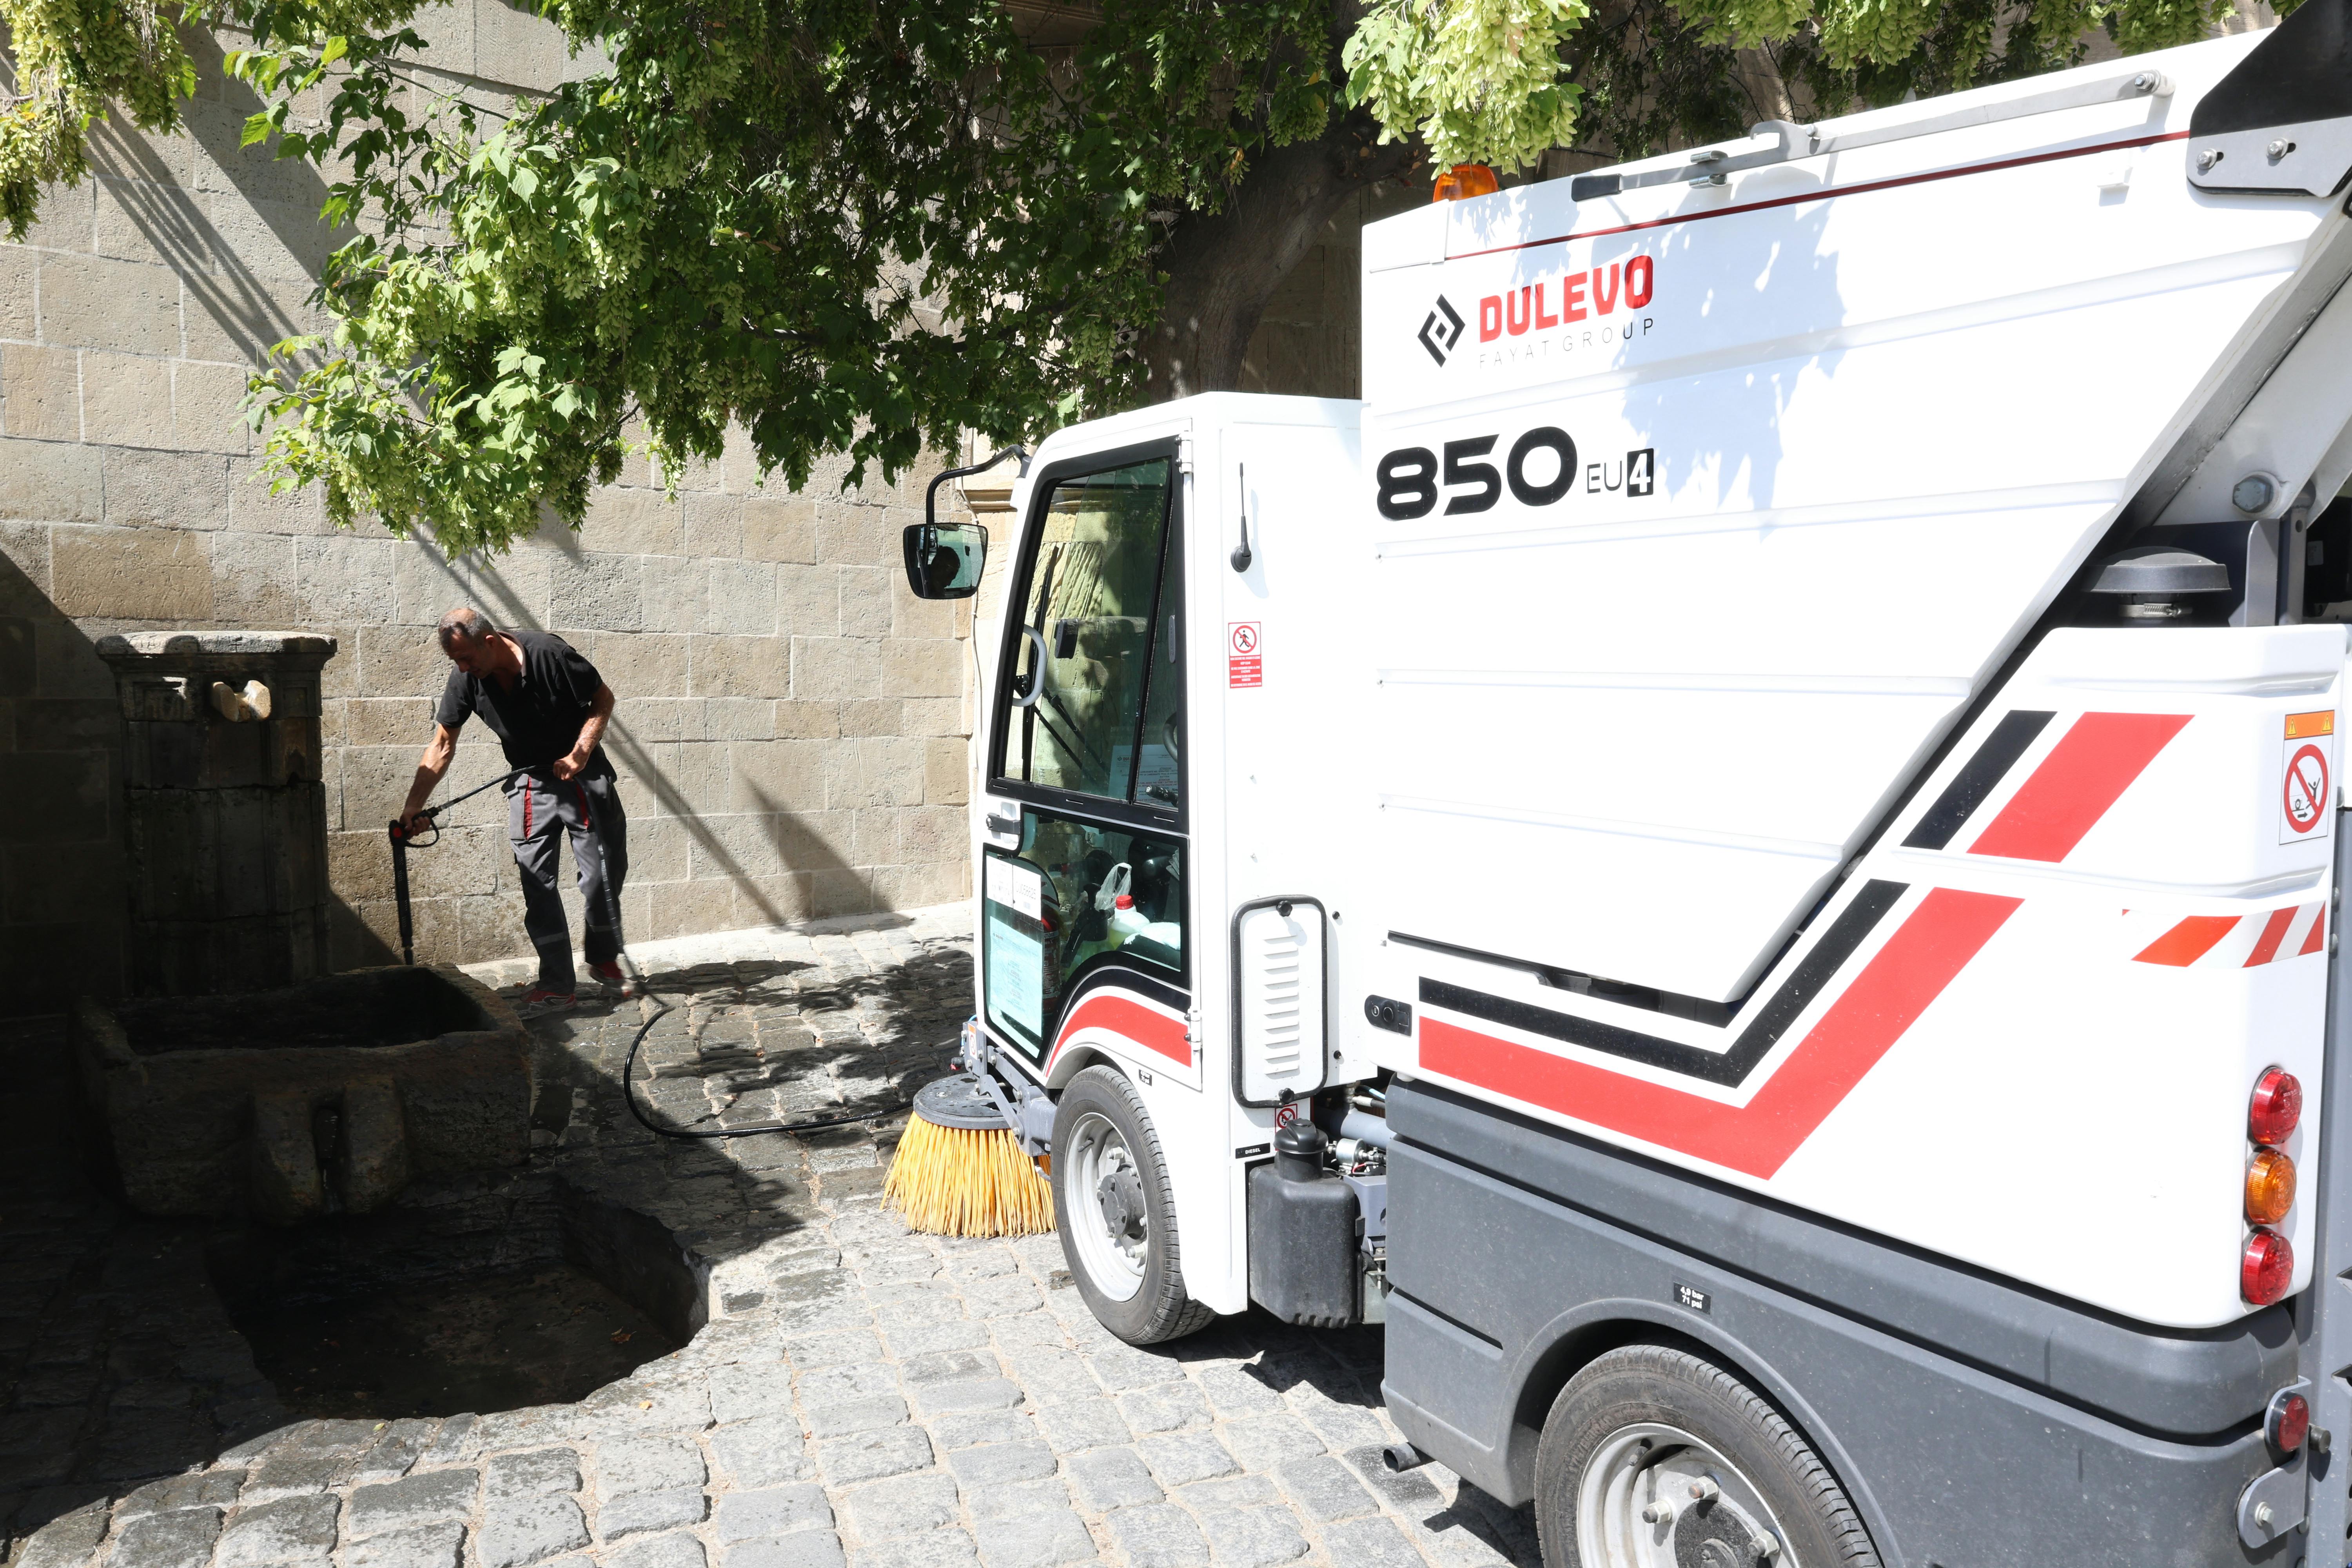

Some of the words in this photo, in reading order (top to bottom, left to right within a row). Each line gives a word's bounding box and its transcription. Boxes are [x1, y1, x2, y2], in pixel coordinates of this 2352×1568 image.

[1480, 255, 1653, 343] DULEVO
[1480, 340, 1549, 369] FAYAT
[1563, 318, 1653, 352] GROUP
[1377, 426, 1577, 521] 850
[1680, 1287, 1691, 1296] 4,9
[1692, 1290, 1704, 1300] bar
[1682, 1295, 1690, 1305] 71
[1691, 1300, 1702, 1309] psi
